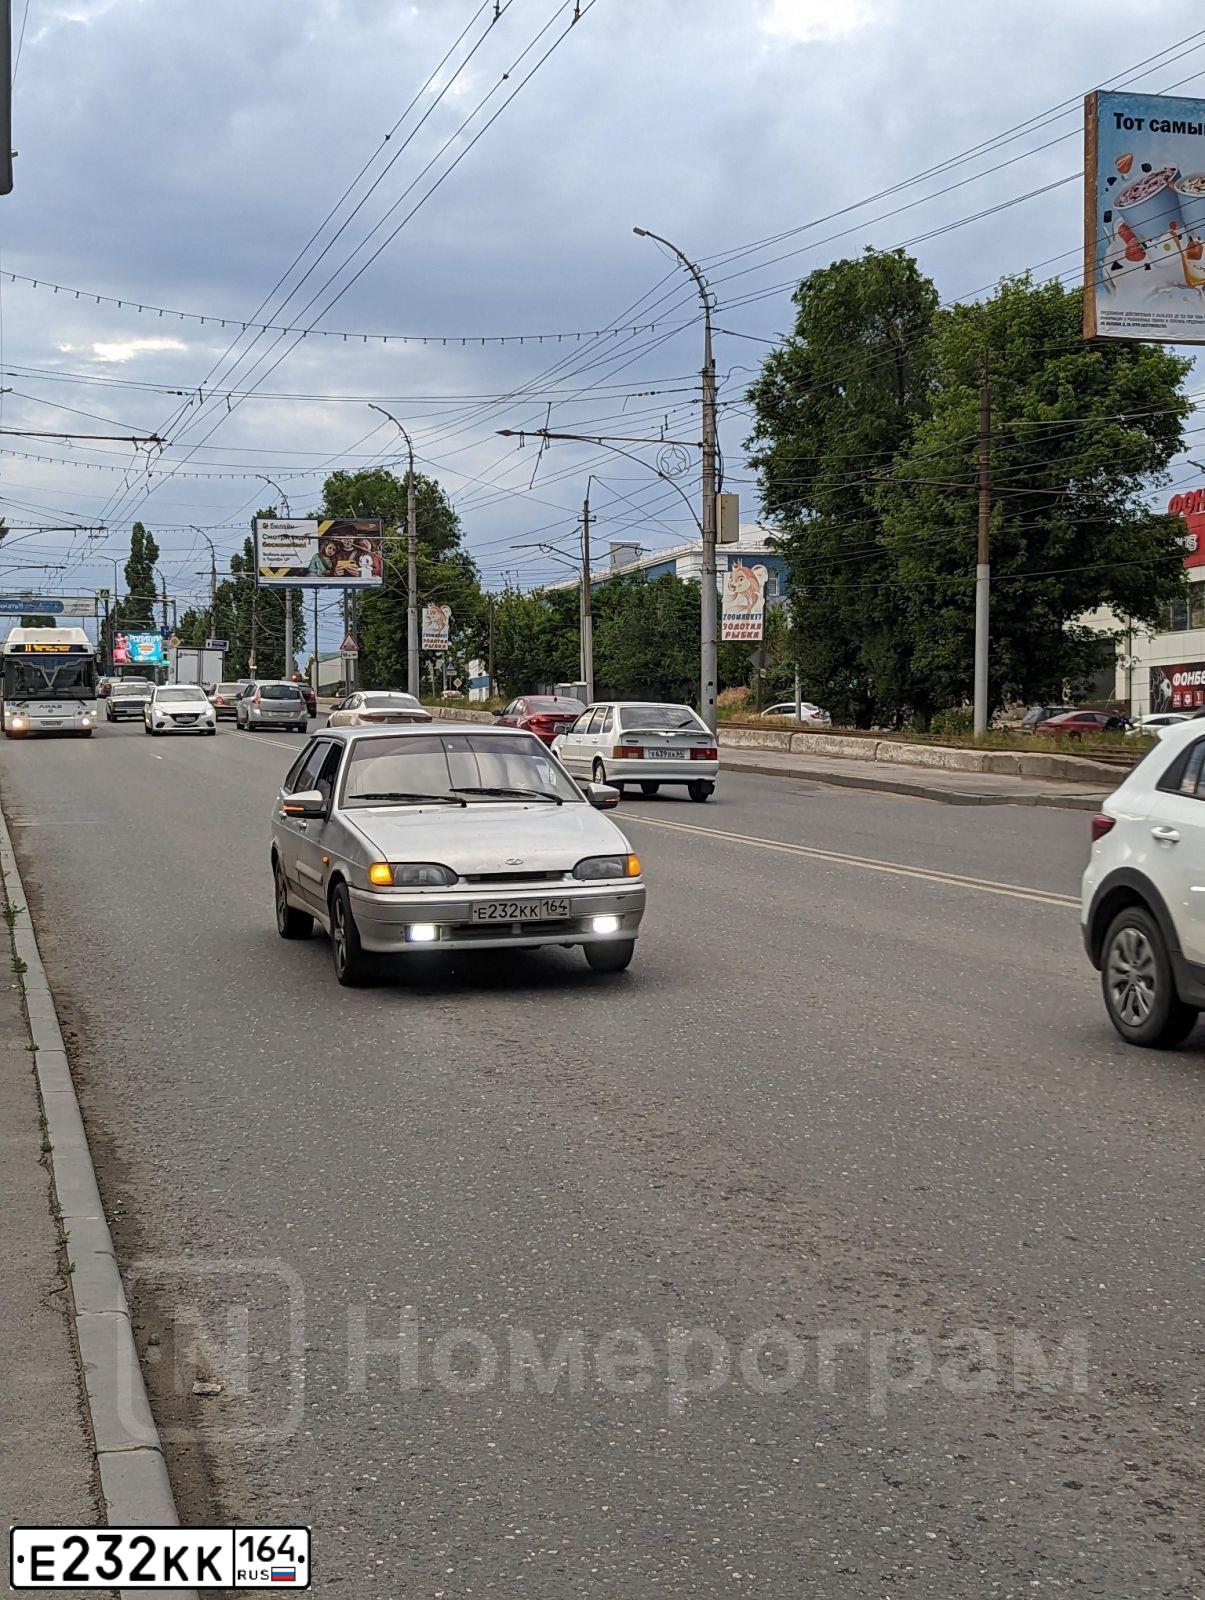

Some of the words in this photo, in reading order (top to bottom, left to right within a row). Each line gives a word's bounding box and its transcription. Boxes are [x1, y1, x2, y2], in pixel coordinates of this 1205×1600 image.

[1113, 112, 1145, 131] Тот
[1149, 119, 1205, 136] самы
[725, 631, 760, 639] РЫБКА
[542, 900, 568, 912] 164
